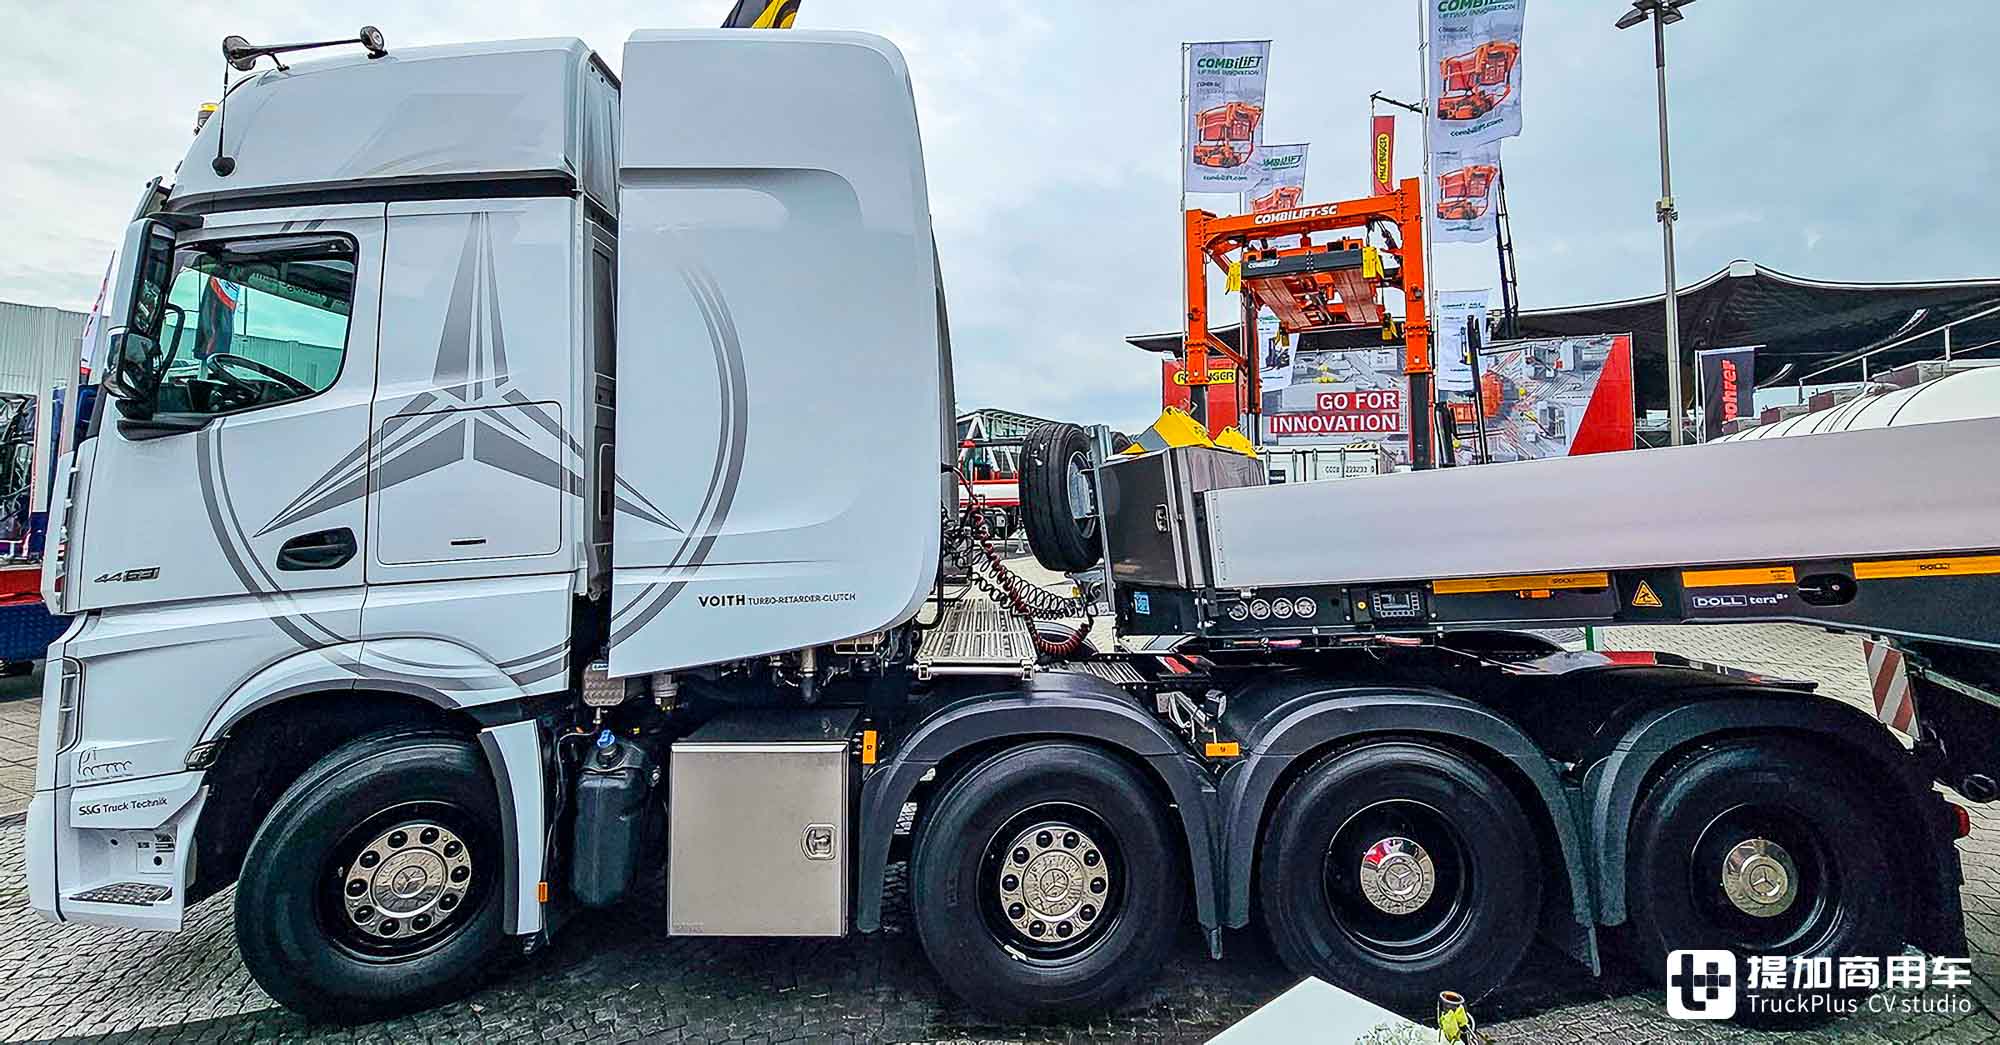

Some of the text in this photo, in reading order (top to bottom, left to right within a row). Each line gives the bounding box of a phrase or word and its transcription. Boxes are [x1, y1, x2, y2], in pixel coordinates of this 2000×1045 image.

[1254, 205, 1338, 224] COMBILIFT-SC
[1320, 392, 1397, 410] GO FOR
[1272, 414, 1397, 433] INNOVATION
[698, 595, 745, 607] VOITH
[1696, 597, 1744, 606] DOLL
[80, 797, 168, 815] S&G Truck Technik
